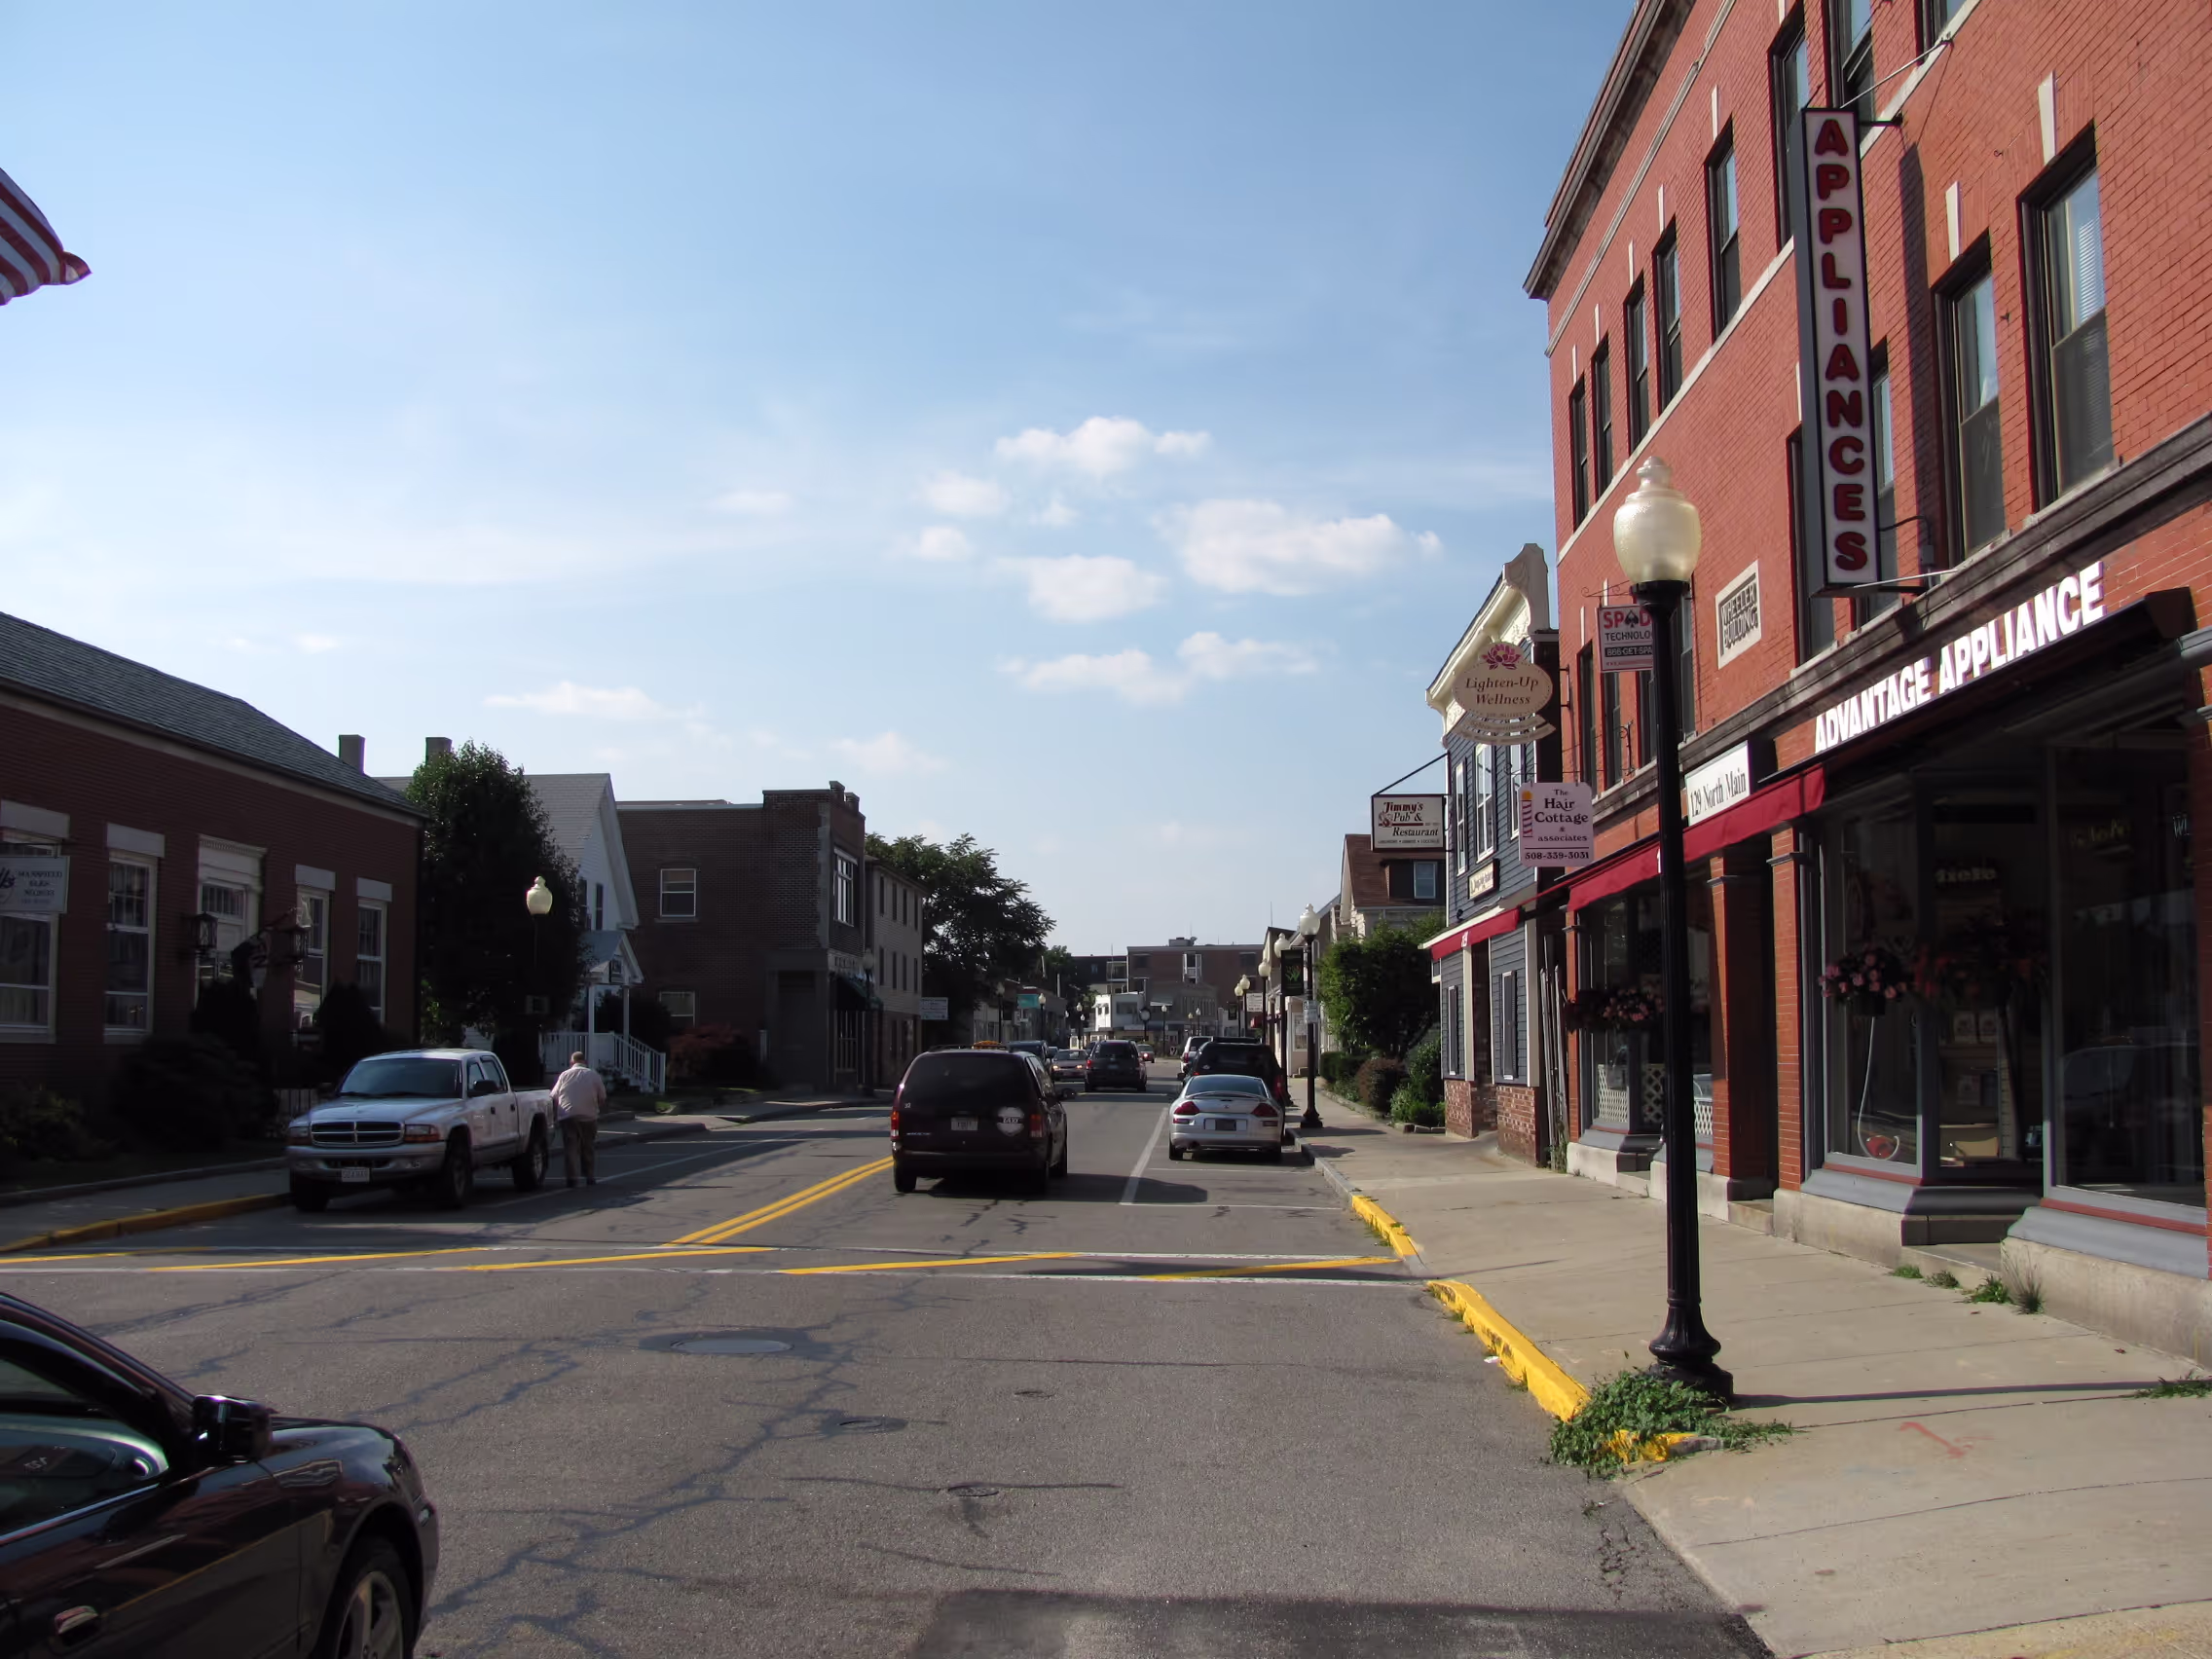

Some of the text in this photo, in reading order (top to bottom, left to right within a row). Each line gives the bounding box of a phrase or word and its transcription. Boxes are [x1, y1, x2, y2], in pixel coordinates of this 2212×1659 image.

[1814, 118, 1868, 572] APPLIANCES
[1720, 582, 1757, 625] WHEELER
[1604, 630, 1652, 642] TECHNOLO
[1815, 561, 2108, 754] ADVANTAGE APPLIANCE
[1465, 676, 1539, 692] Lighten-Up
[1475, 693, 1531, 706] Wellness
[1690, 767, 1747, 818] 129 North Main
[1383, 801, 1424, 814] Jimmy's
[1544, 798, 1575, 812] Hair
[1393, 812, 1422, 822] Pub &
[1534, 811, 1589, 826] Cottage
[1392, 827, 1439, 836] Restaurant
[1525, 851, 1590, 860] 508-339-3031
